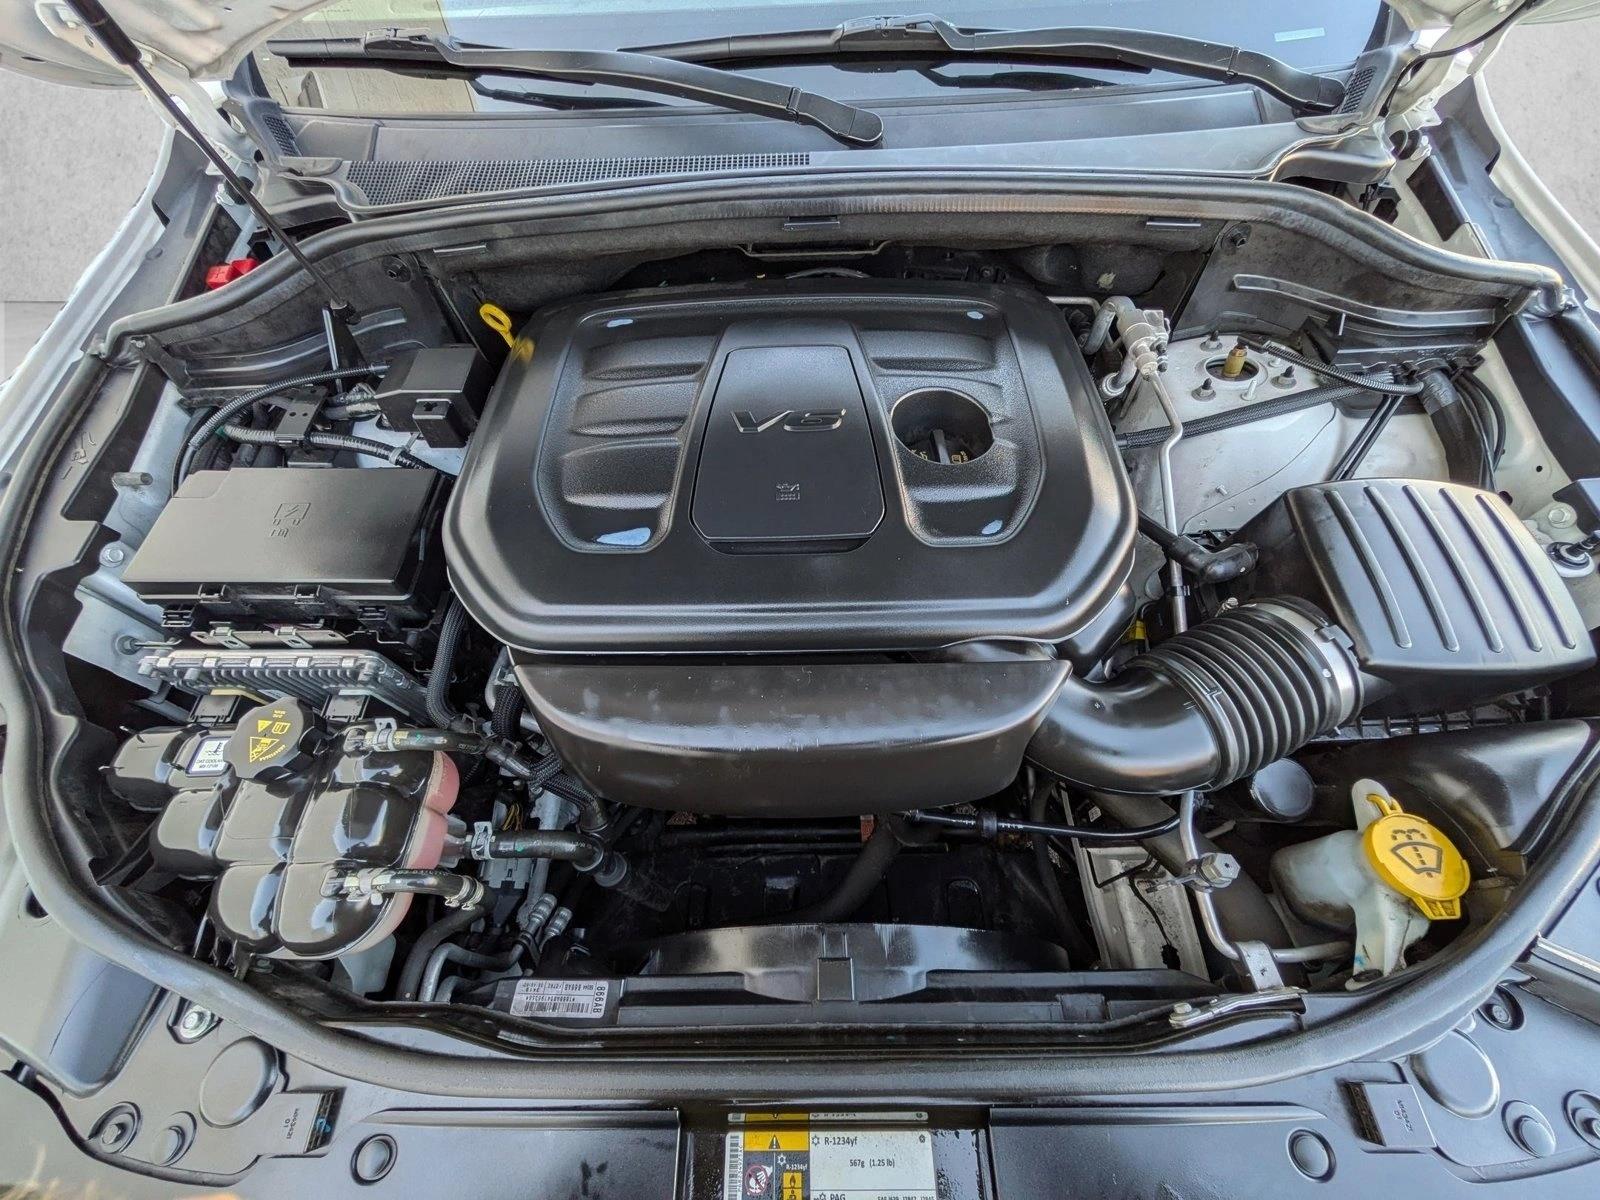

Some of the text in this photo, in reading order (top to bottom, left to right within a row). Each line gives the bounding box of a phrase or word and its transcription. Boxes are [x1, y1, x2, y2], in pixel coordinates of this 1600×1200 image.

[730, 408, 847, 433] V6
[824, 1136, 858, 1147] R-1234yf
[849, 1159, 865, 1168] 567g
